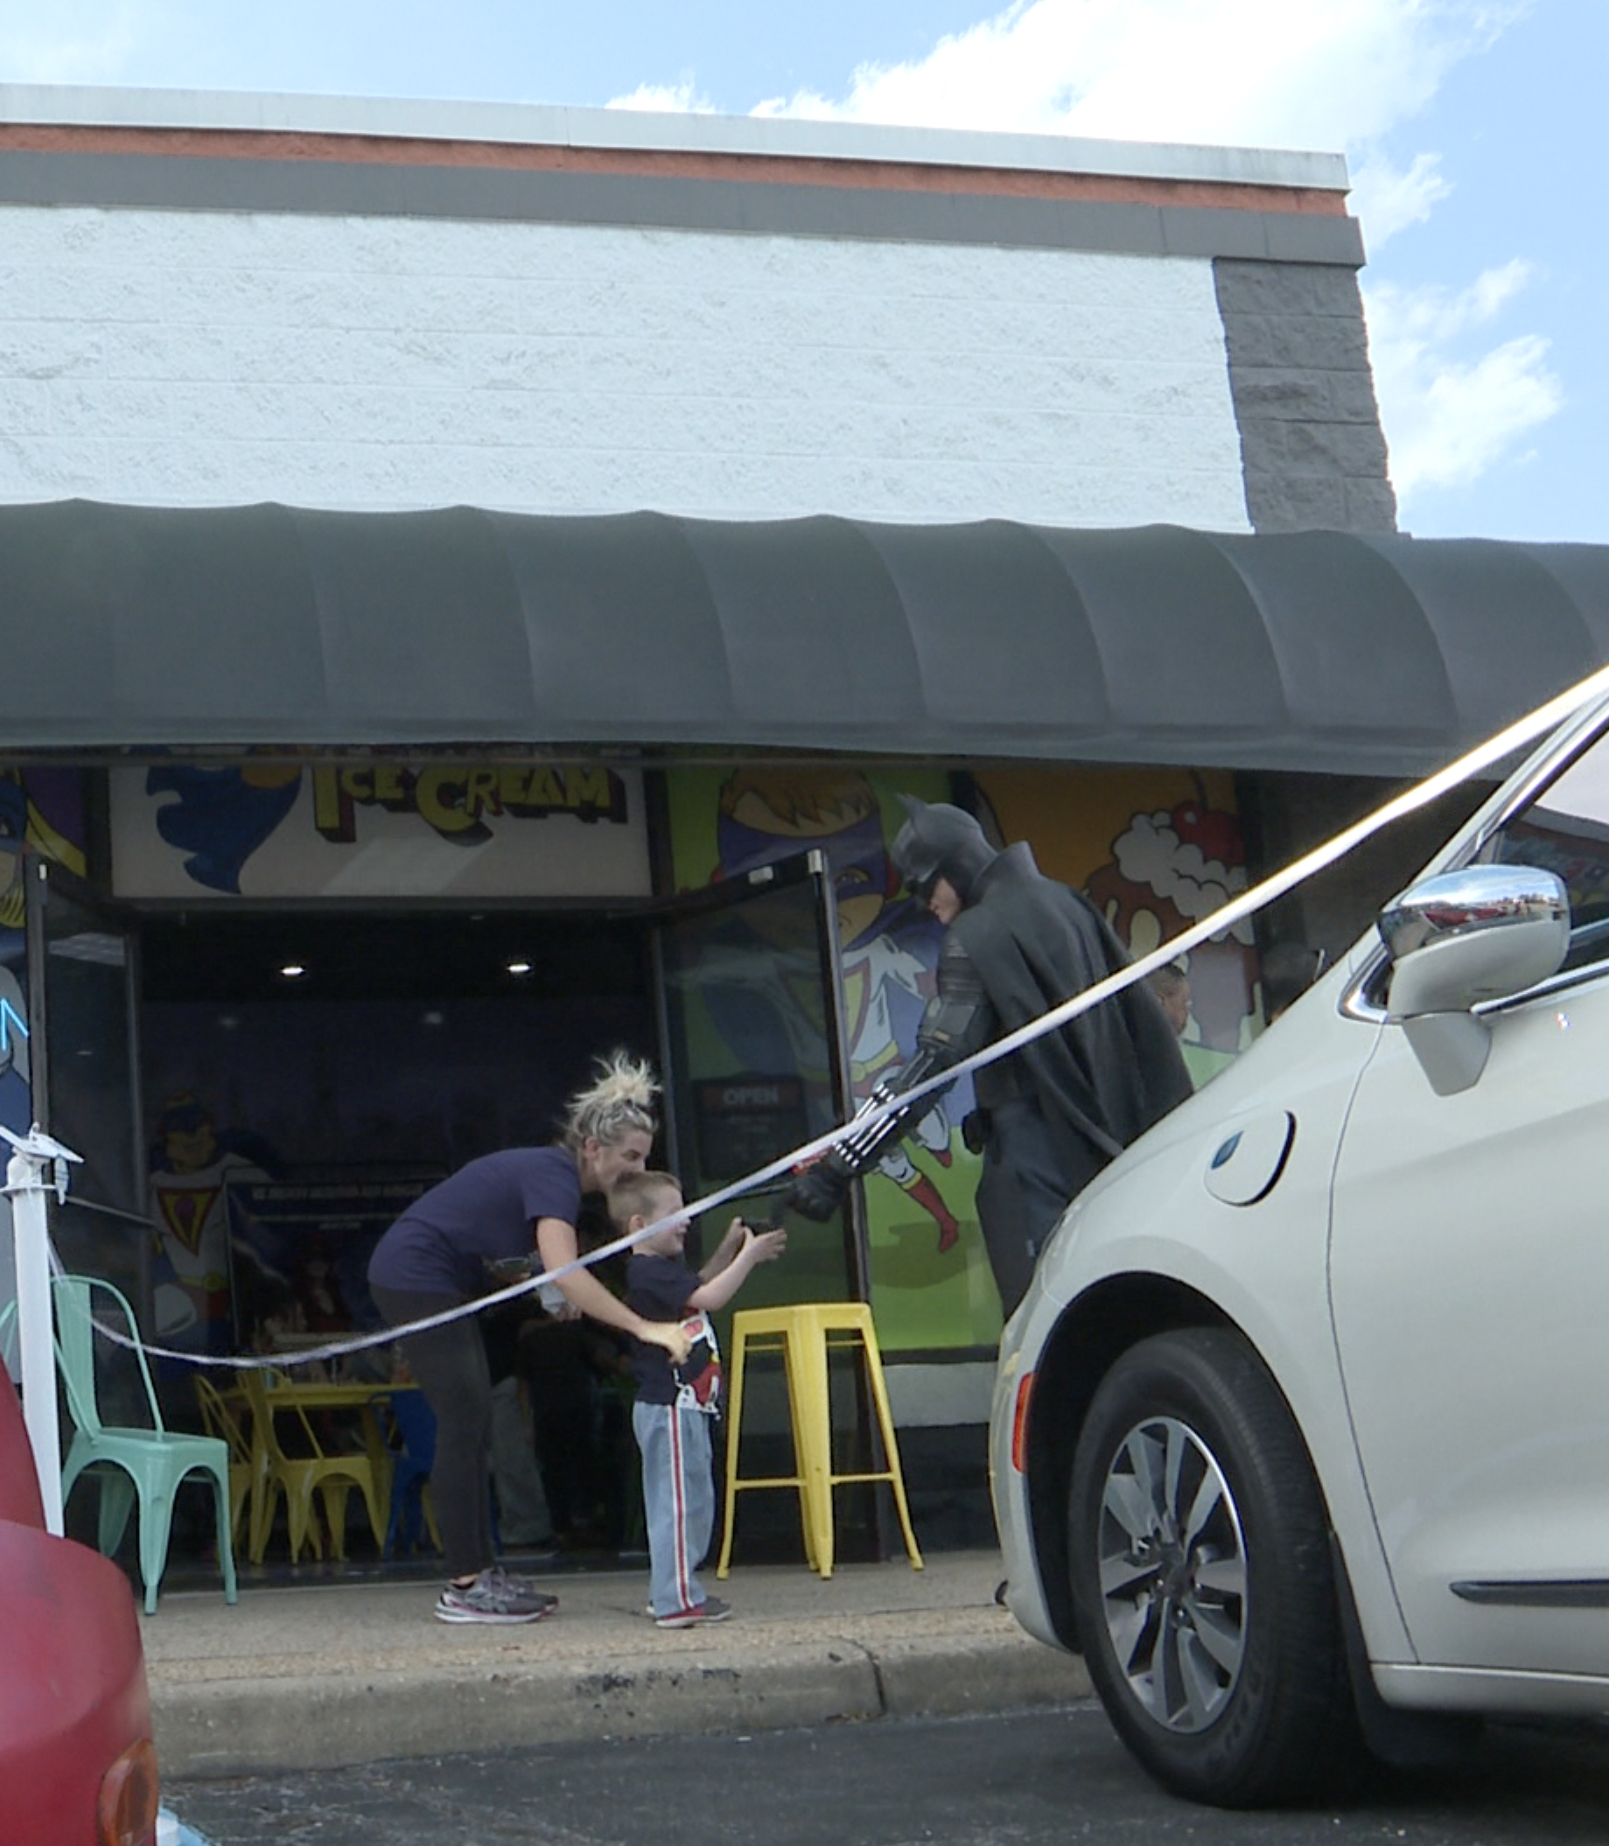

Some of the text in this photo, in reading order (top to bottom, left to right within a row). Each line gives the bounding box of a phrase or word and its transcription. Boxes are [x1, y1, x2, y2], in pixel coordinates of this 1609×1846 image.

[313, 766, 627, 845] ICE CREAM
[722, 1087, 779, 1105] OPEN
